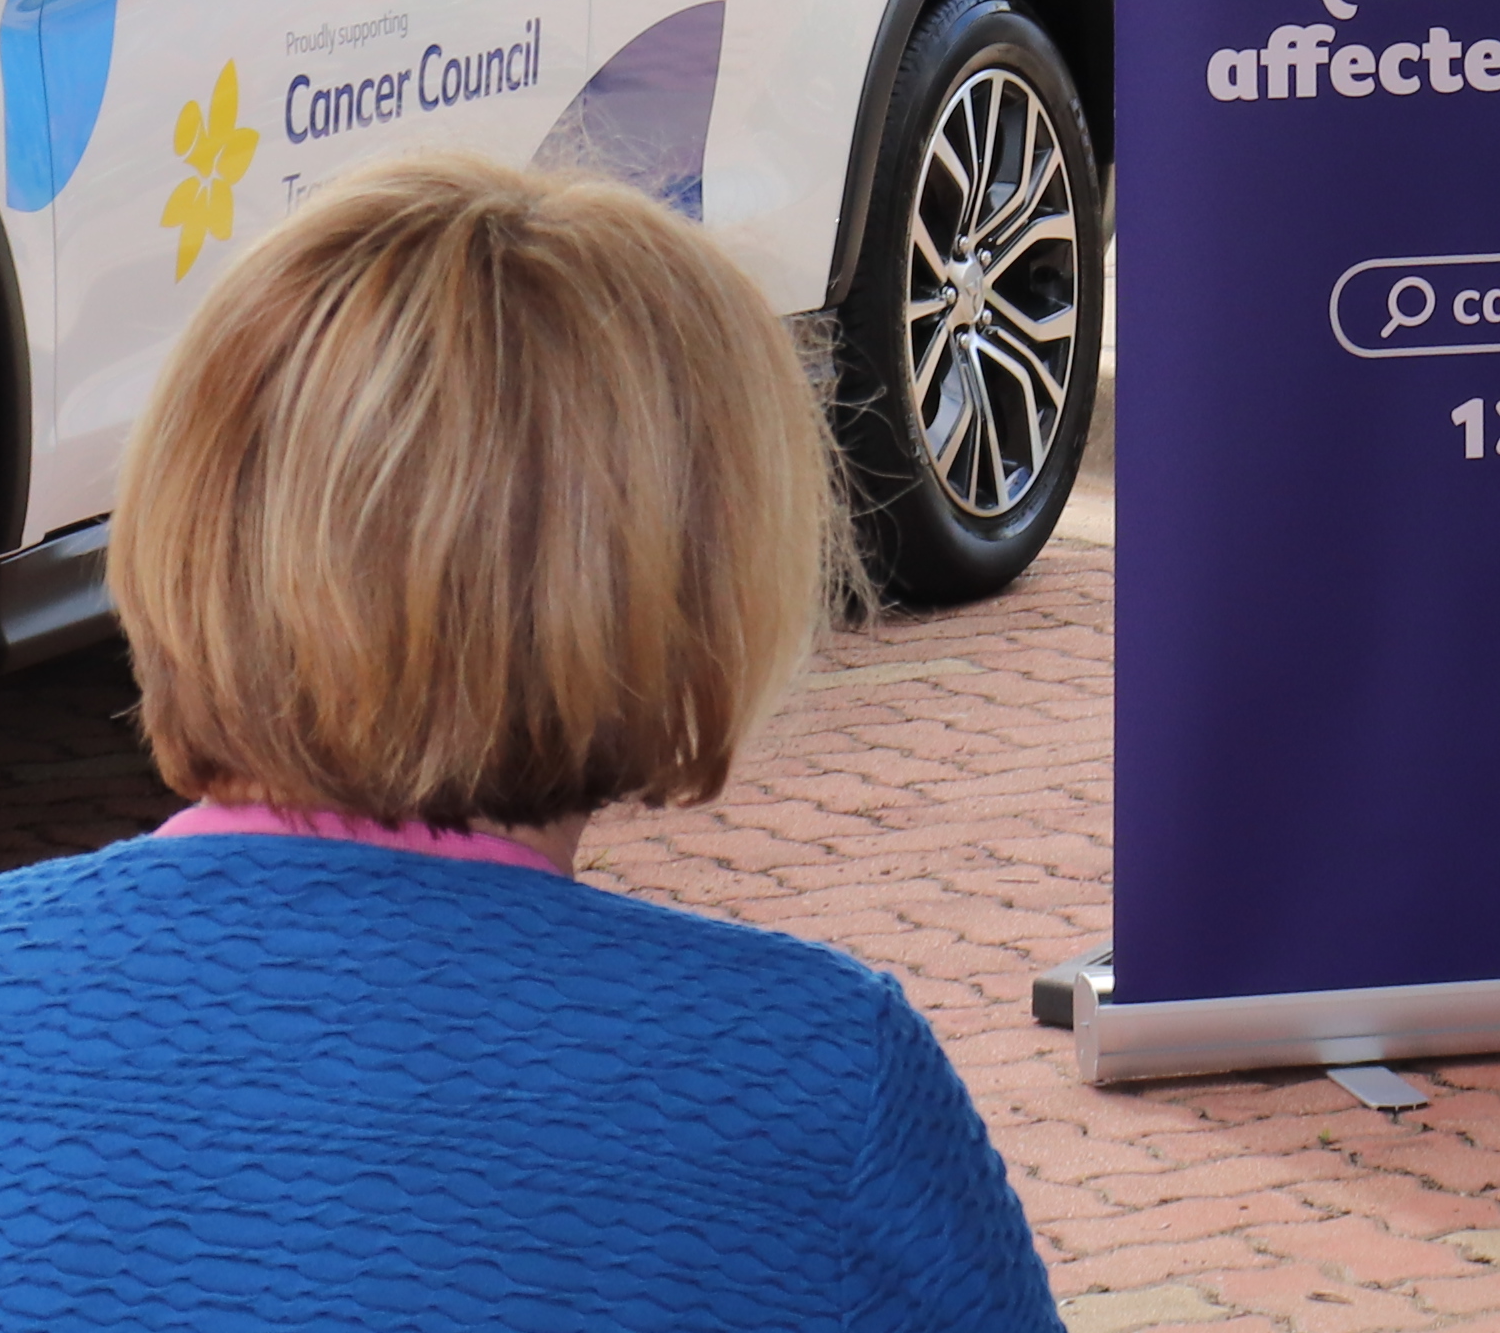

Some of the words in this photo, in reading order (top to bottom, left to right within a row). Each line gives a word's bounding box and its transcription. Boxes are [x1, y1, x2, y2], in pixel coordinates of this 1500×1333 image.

[286, 23, 336, 55] Proudly
[338, 10, 408, 49] supporting
[284, 68, 412, 145] Cancer
[418, 17, 542, 112] Council
